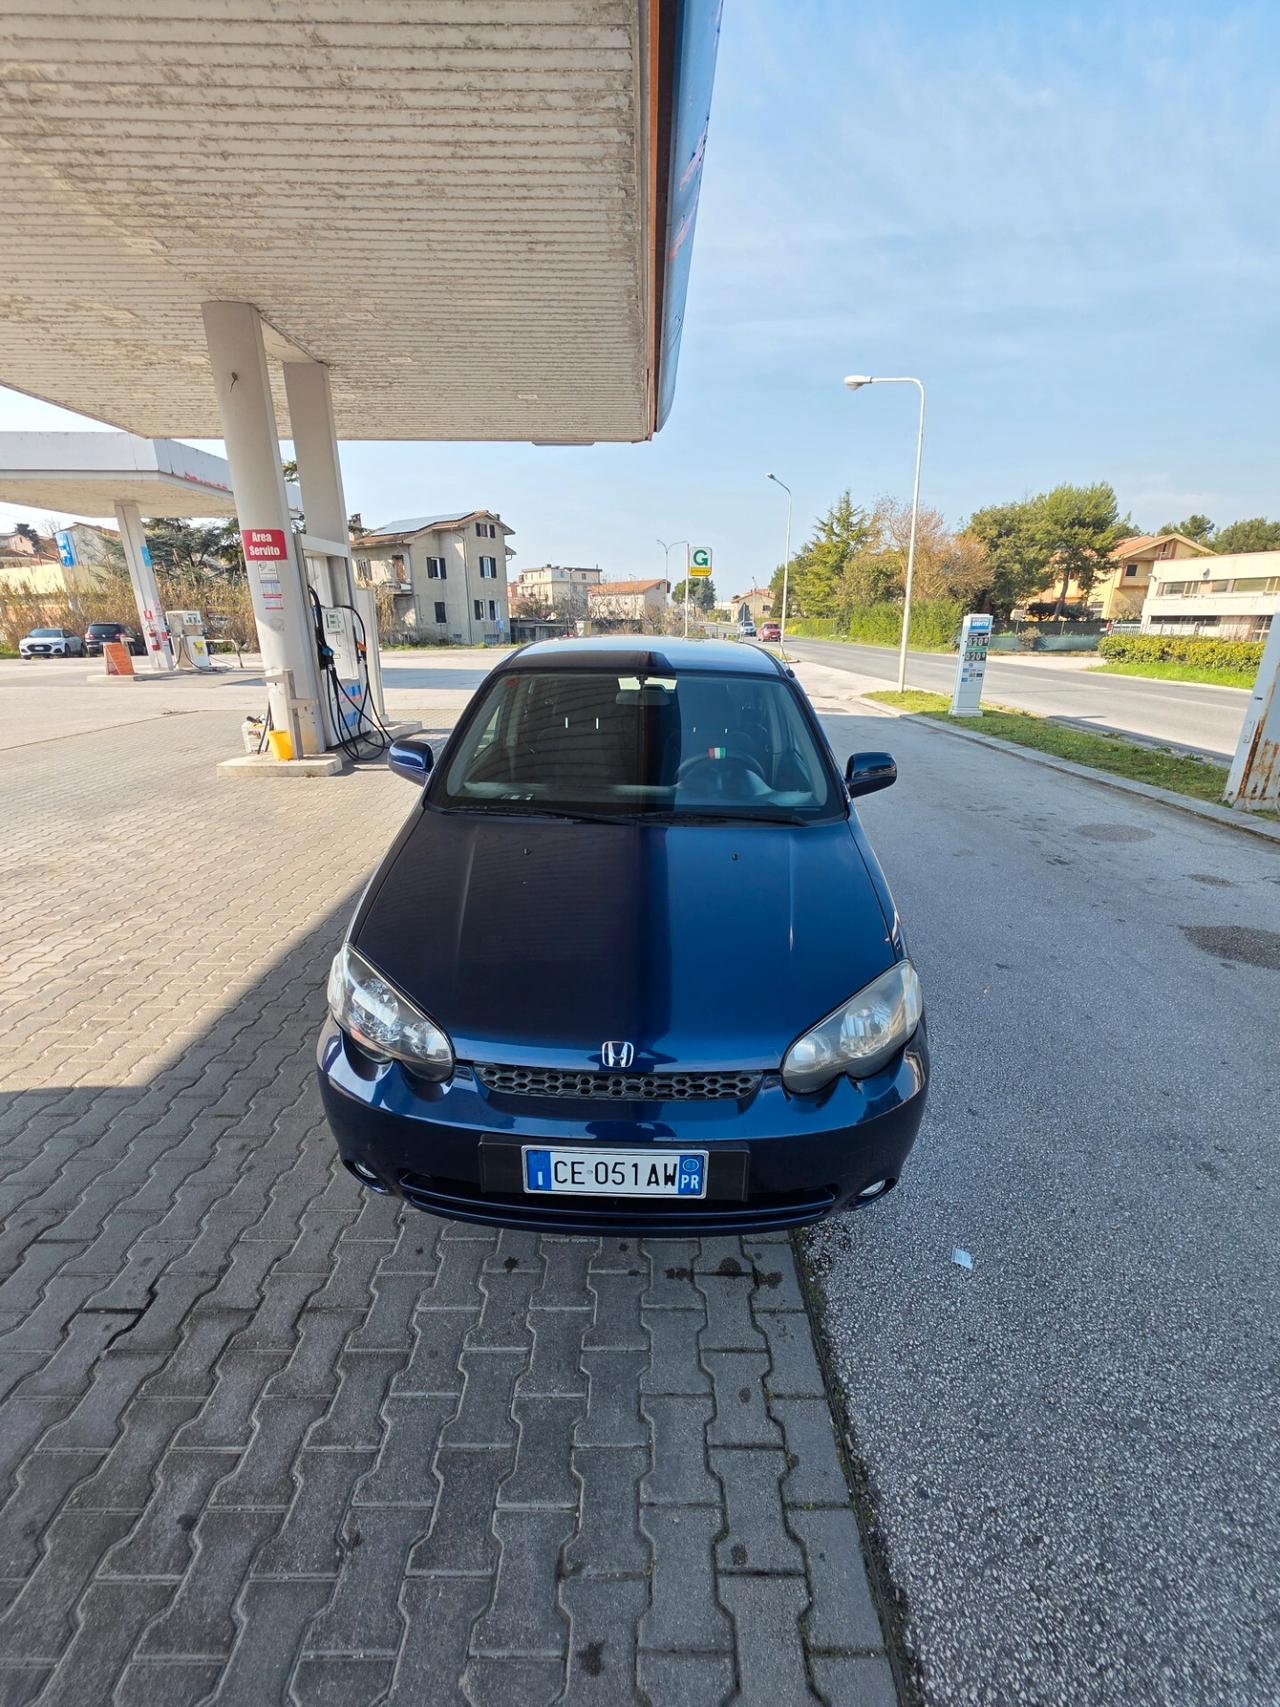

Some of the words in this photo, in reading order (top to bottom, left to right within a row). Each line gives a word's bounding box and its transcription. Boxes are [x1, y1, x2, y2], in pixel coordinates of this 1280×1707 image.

[251, 532, 272, 543] Area
[249, 545, 280, 556] Servito
[693, 549, 708, 566] G
[681, 1174, 699, 1190] PR
